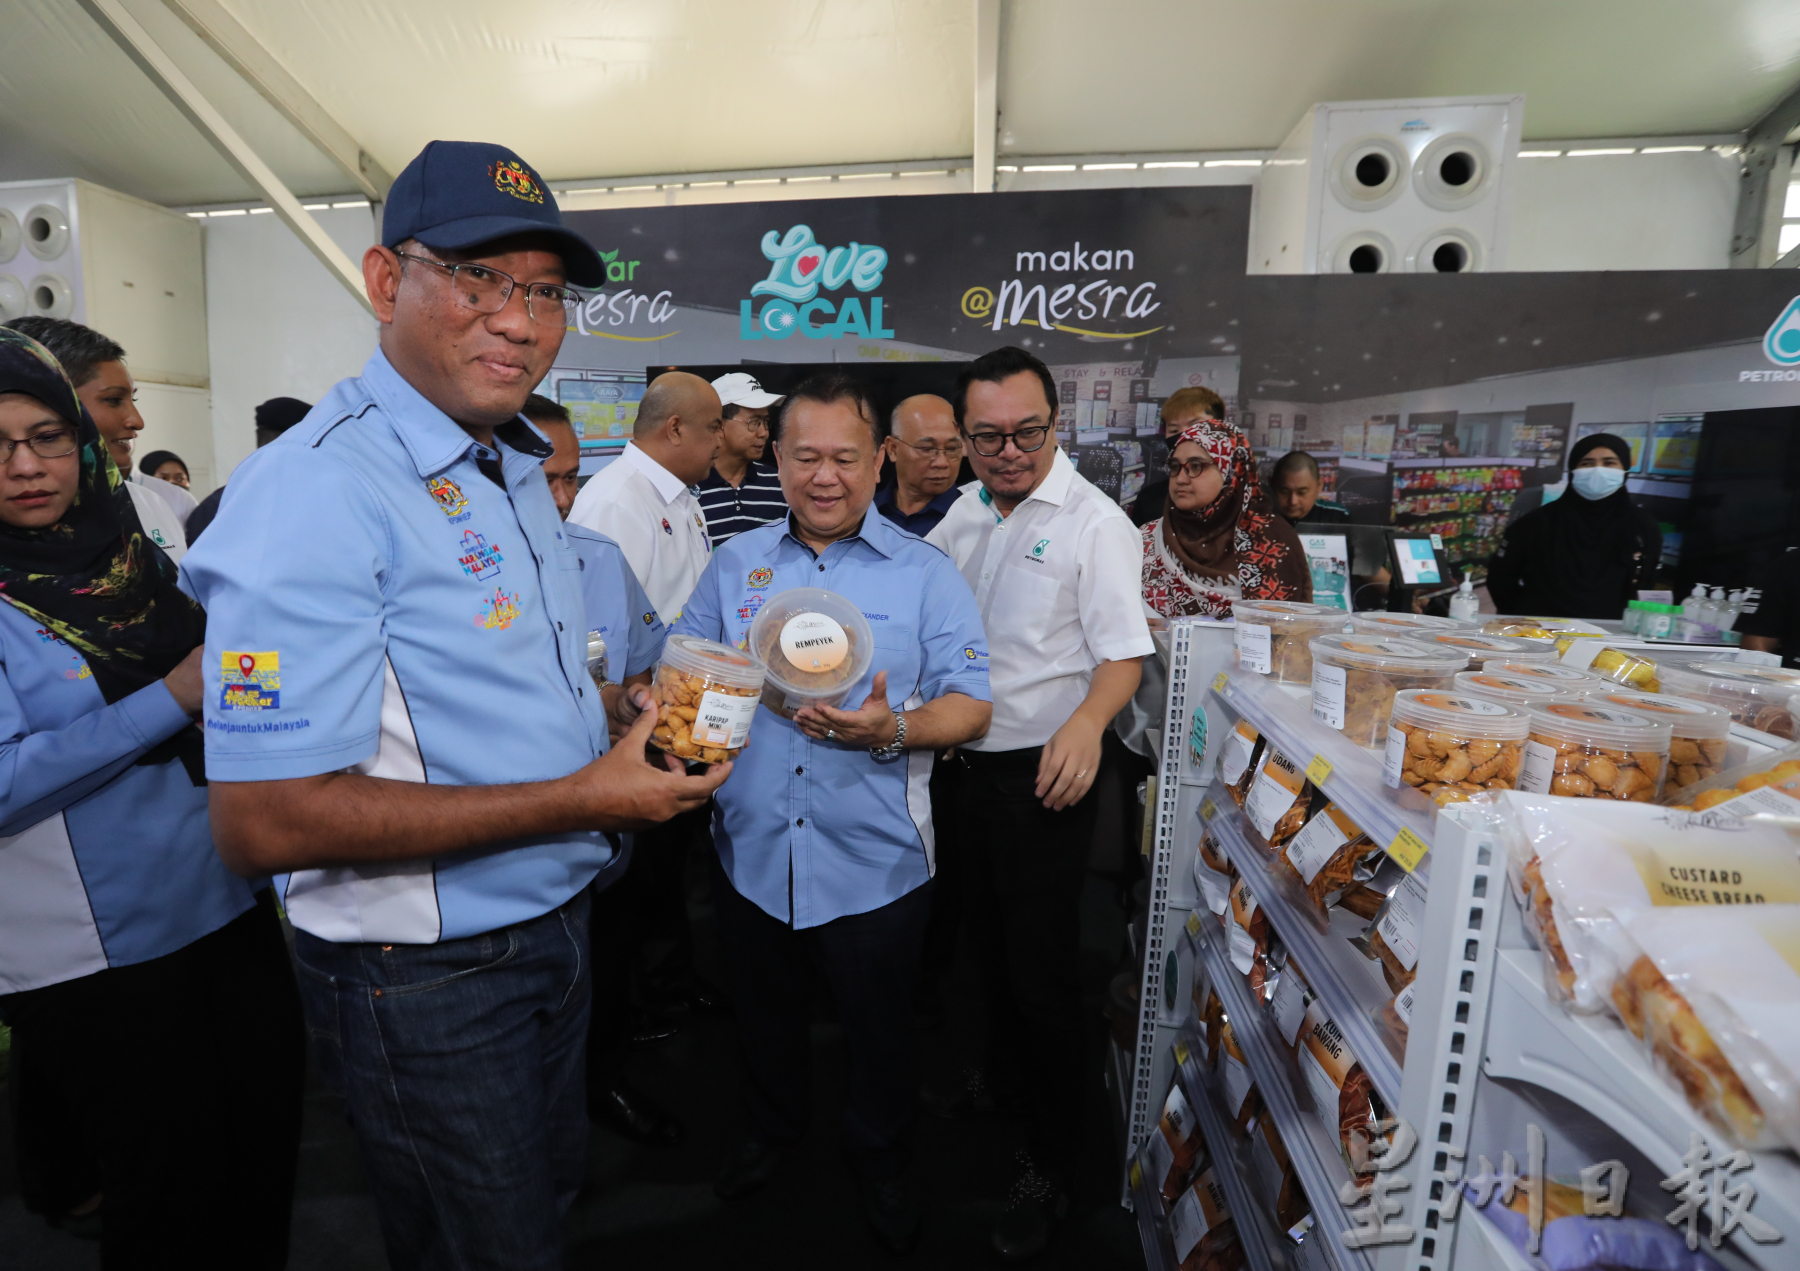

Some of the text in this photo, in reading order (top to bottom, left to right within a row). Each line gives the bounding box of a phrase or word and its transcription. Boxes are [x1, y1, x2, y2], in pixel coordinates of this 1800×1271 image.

[750, 224, 888, 303] Love
[1016, 241, 1134, 272] makan
[740, 297, 894, 340] LOCAL
[1064, 369, 1089, 378] STAY
[1739, 370, 1800, 382] PETRO
[459, 544, 500, 566] BARANGAN
[463, 555, 504, 576] MALAYSIA
[795, 636, 834, 649] REMPEYEK
[705, 714, 729, 725] KARIPAP
[708, 722, 722, 730] MINI
[1272, 753, 1295, 774] UDANG
[1670, 867, 1742, 885] CUSTARD
[1661, 882, 1709, 903] CHEESE
[1324, 1018, 1343, 1042] KUIH
[1313, 1022, 1342, 1060] BAWANG
[1172, 1109, 1183, 1126] KUIH
[1207, 1181, 1224, 1213] BAWANG
